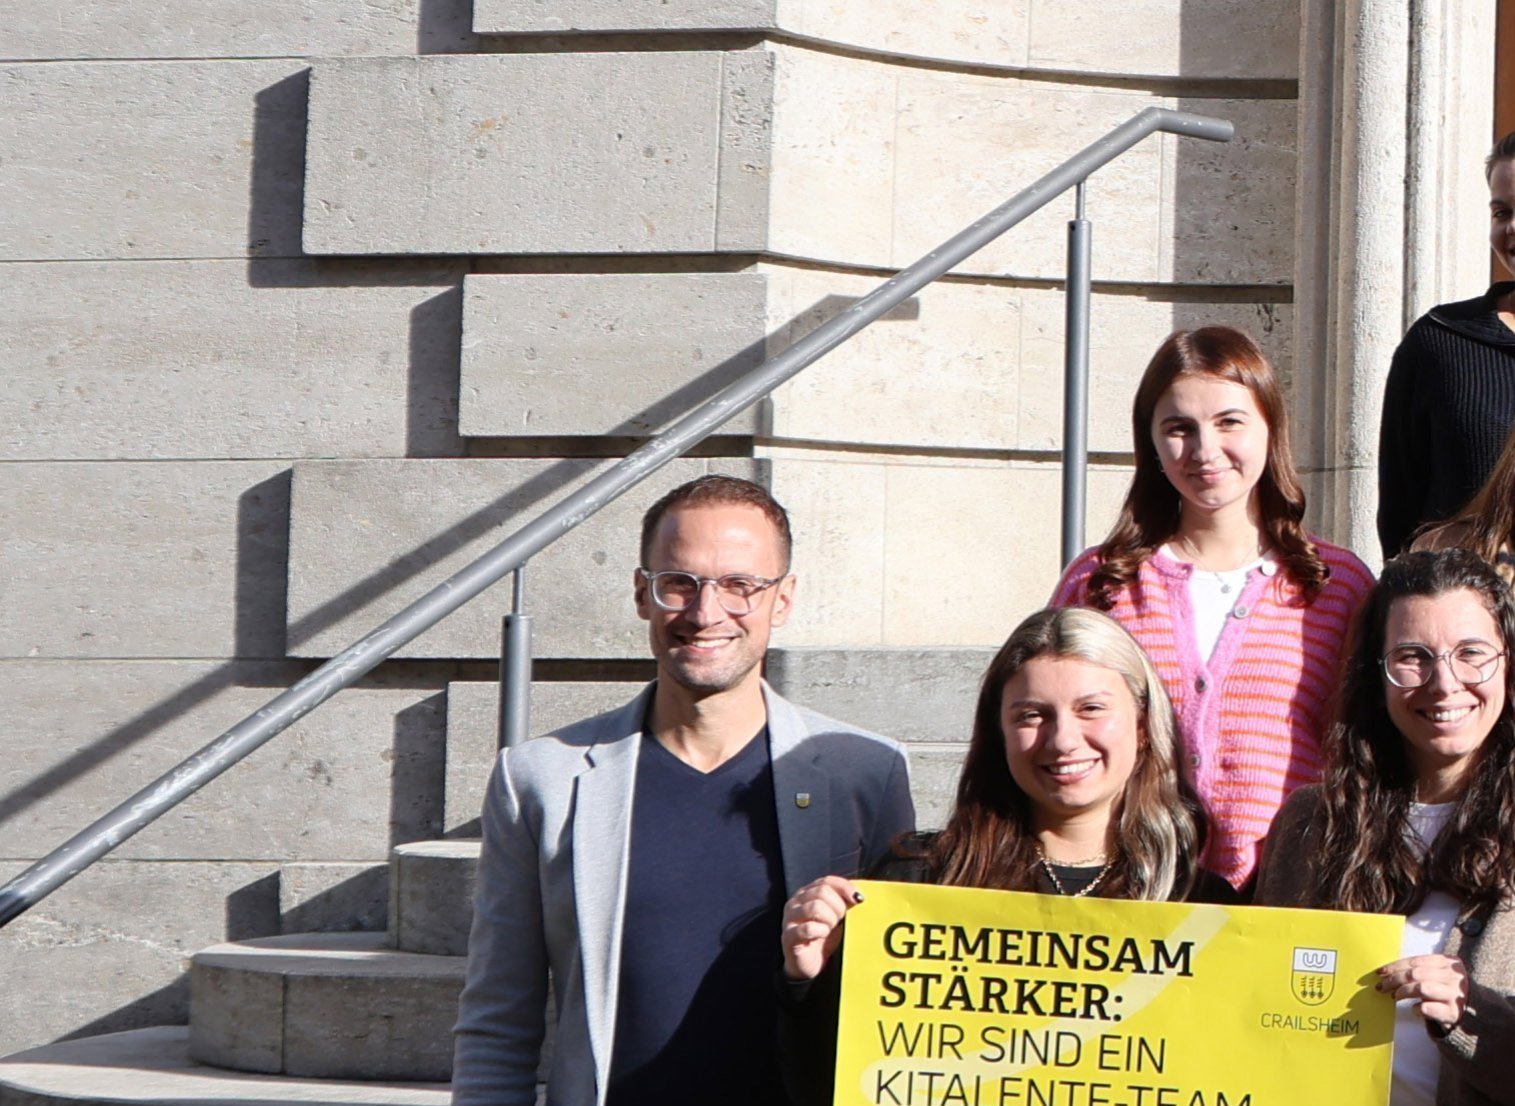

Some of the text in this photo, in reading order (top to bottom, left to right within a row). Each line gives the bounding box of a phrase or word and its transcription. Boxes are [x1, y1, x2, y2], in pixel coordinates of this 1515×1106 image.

[883, 921, 1195, 977] GEMEINSAM
[880, 965, 1123, 1022] STÄRKER:
[877, 1020, 1165, 1074] WIR SIND EIN
[1261, 1013, 1360, 1034] CRAILSHEIM
